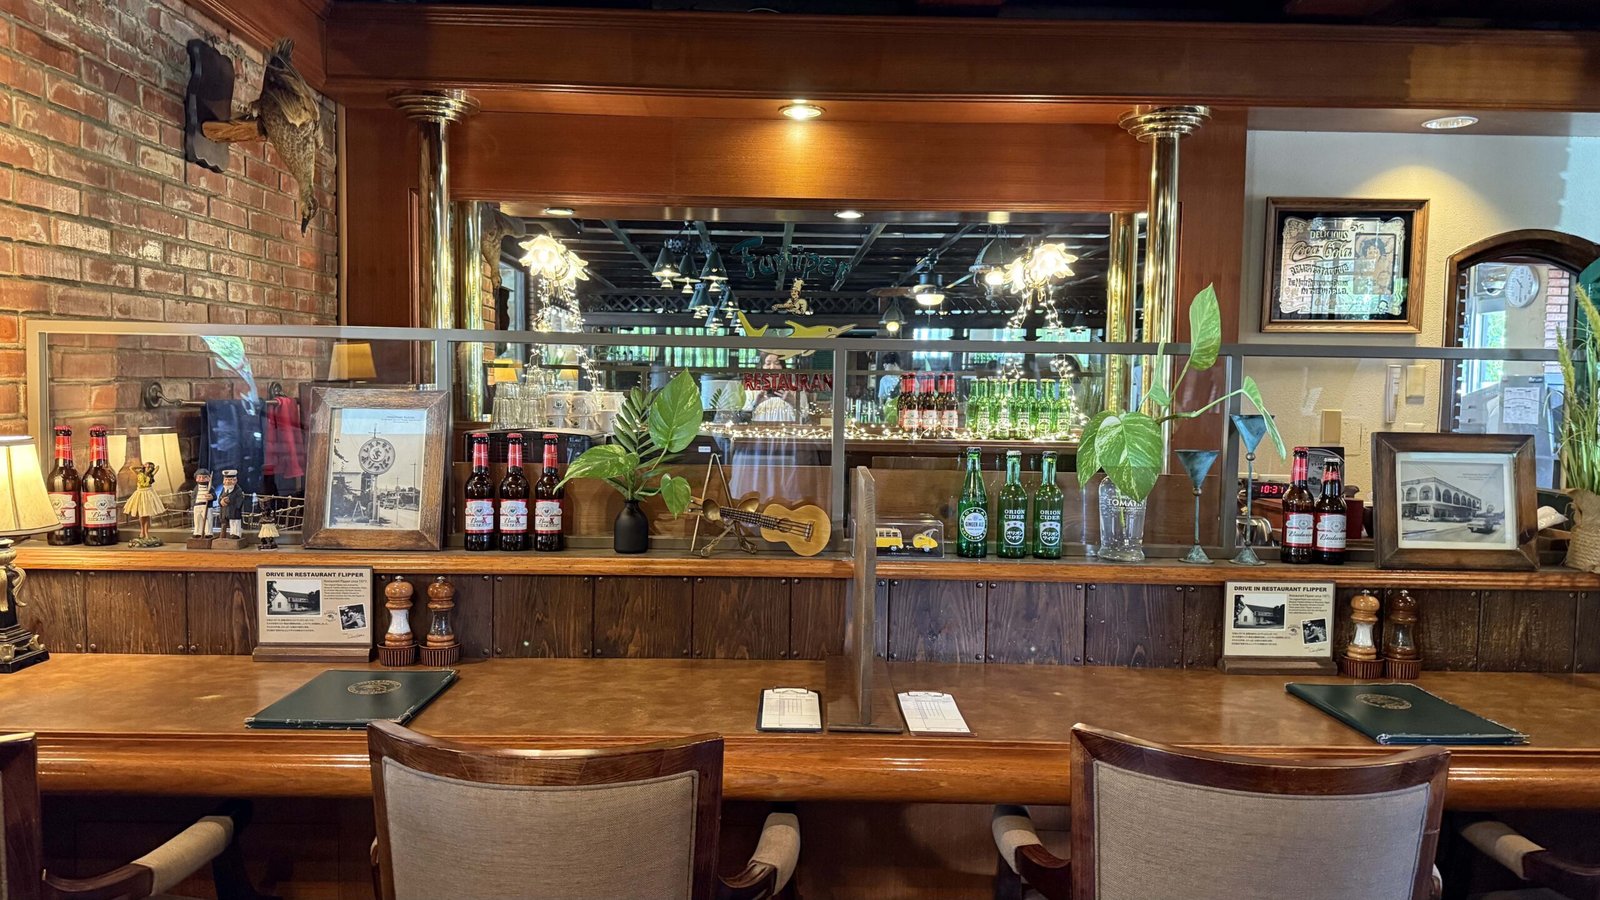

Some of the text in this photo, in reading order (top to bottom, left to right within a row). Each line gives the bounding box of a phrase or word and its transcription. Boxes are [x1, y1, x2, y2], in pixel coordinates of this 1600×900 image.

[1310, 230, 1349, 239] DELICIOUS
[743, 372, 834, 392] RESTAURAN
[1260, 485, 1284, 494] 10:31
